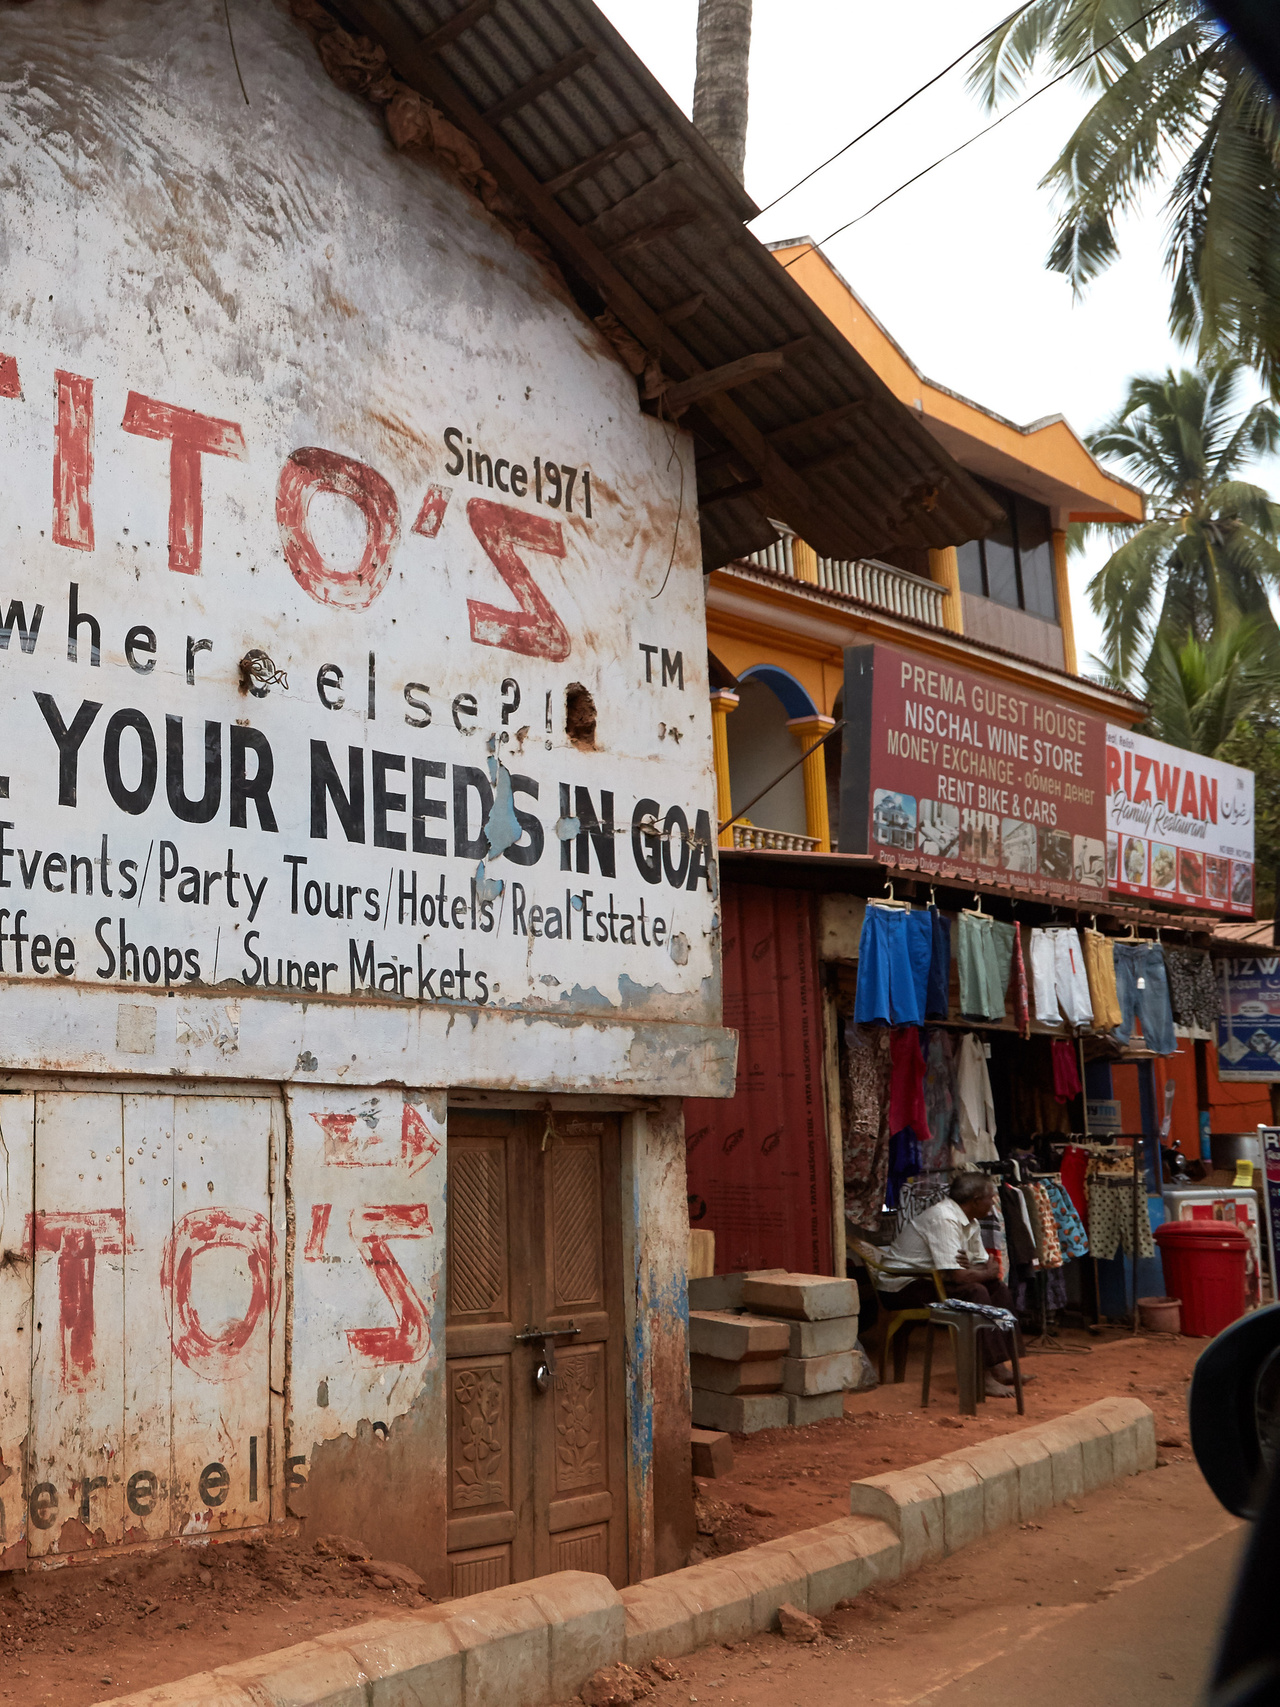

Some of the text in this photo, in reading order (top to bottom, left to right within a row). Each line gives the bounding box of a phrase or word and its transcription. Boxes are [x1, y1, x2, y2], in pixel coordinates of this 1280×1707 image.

[443, 426, 593, 519] Since 1971
[638, 642, 685, 692] TM
[900, 661, 1087, 746] PREMA GUEST HOUSE
[904, 699, 1084, 777] NISCHAL WINE STORE
[32, 690, 280, 833] YOUR
[310, 739, 545, 868] NEEDS
[559, 781, 616, 878] IN
[631, 798, 713, 893] GOA
[887, 729, 939, 765] MONEY
[942, 743, 1015, 786] EXCHANGE
[1024, 768, 1062, 797] обмен
[1064, 782, 1096, 806] денег
[1106, 744, 1218, 826] RIZWAN
[937, 774, 1058, 827] RENT BIKE & CARS
[1111, 790, 1210, 840] Family Restaurant
[801, 1016, 810, 1037] STEEL
[805, 1083, 813, 1106] TATA
[806, 1117, 814, 1138] STEEL
[809, 1184, 817, 1206] TATA
[810, 1216, 818, 1237] STEEL
